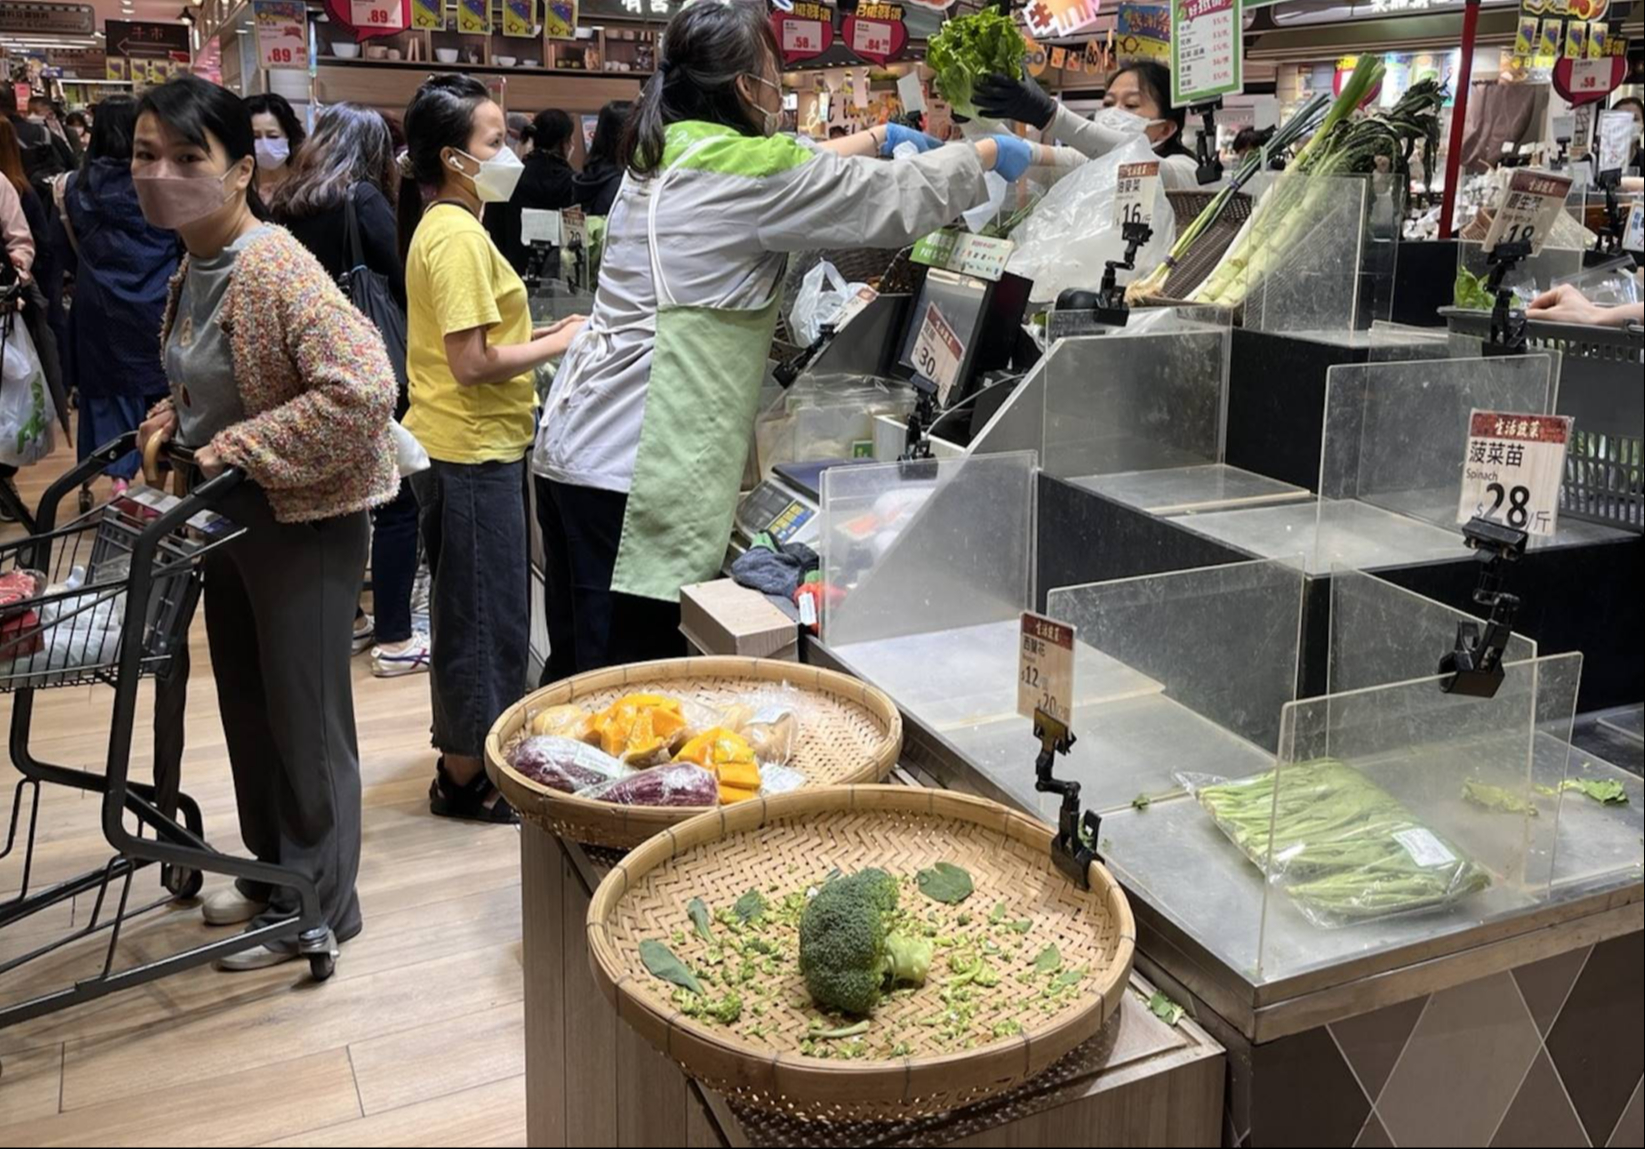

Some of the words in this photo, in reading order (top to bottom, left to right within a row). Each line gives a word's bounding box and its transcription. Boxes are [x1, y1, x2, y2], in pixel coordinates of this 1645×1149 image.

[1494, 418, 1541, 438] 生活蔬菜
[1468, 440, 1526, 467] 菠菜苗
[1465, 467, 1499, 481] Spinach
